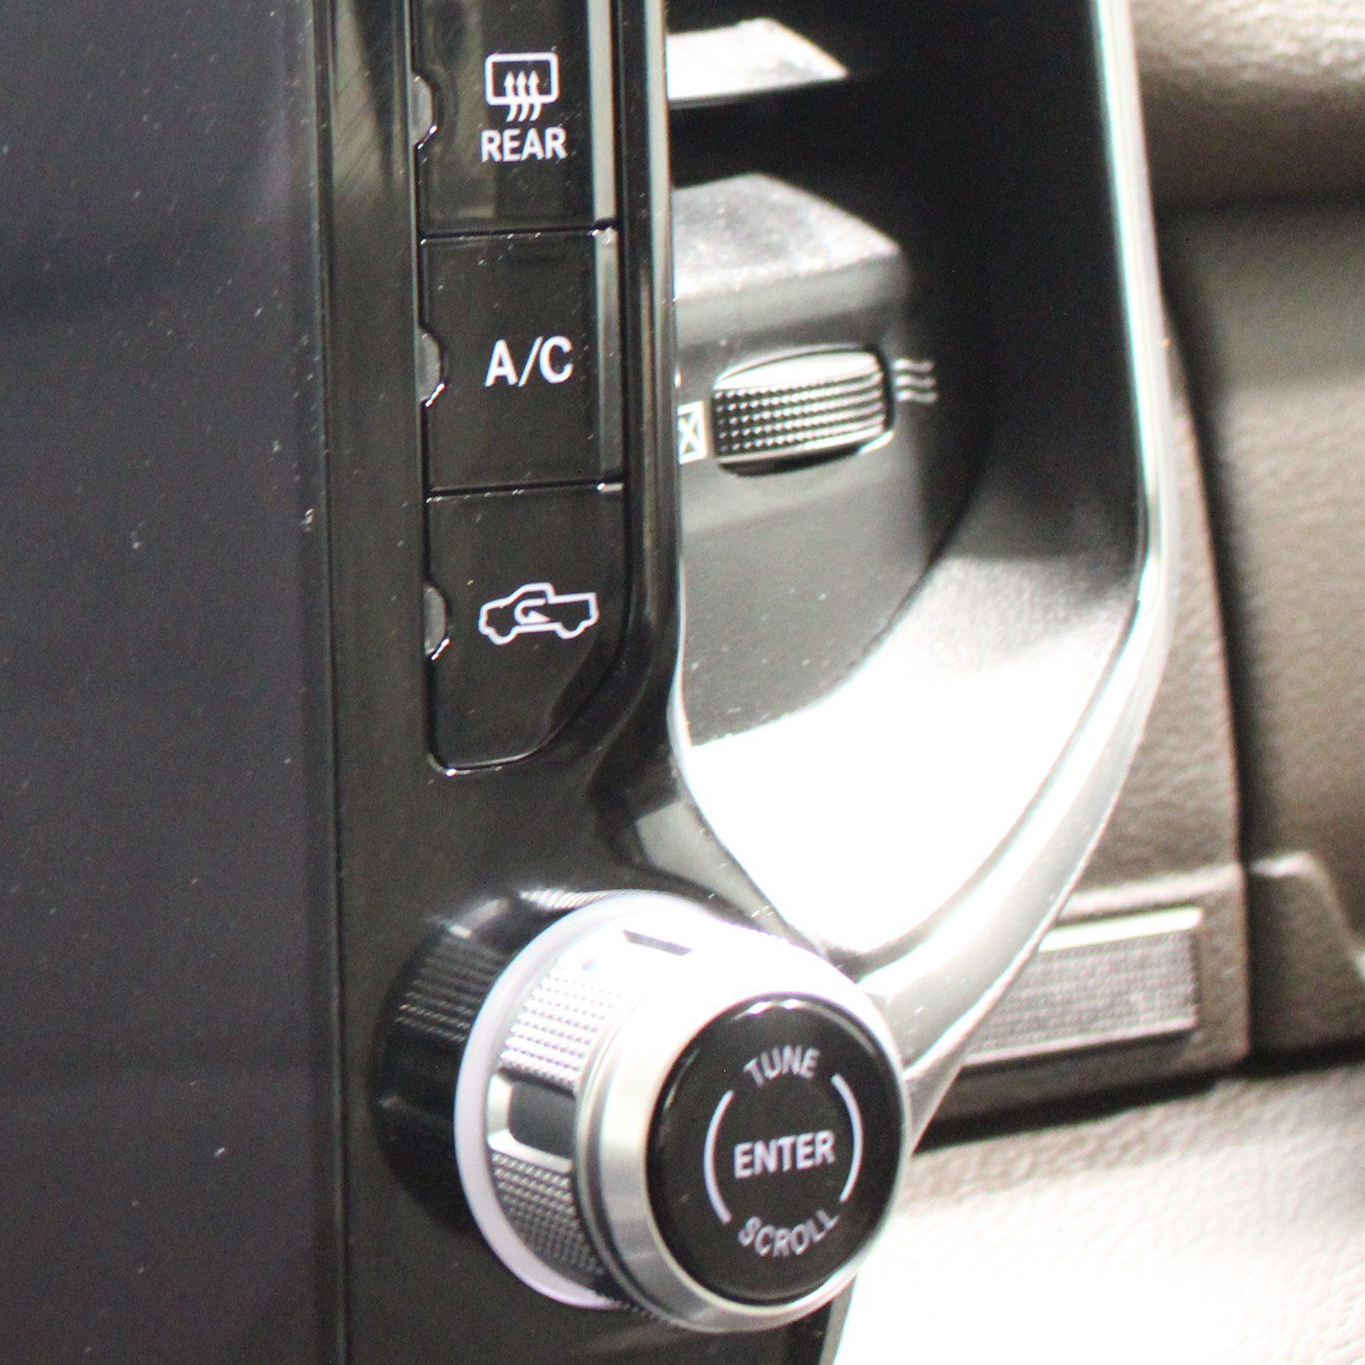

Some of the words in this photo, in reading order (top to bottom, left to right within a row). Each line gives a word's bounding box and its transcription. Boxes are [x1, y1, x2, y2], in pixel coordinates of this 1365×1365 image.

[480, 127, 567, 162] REAR
[484, 336, 574, 387] A/C
[744, 1045, 820, 1087] TUNE
[734, 1130, 836, 1178] ENTER
[738, 1208, 839, 1256] SCROLL
